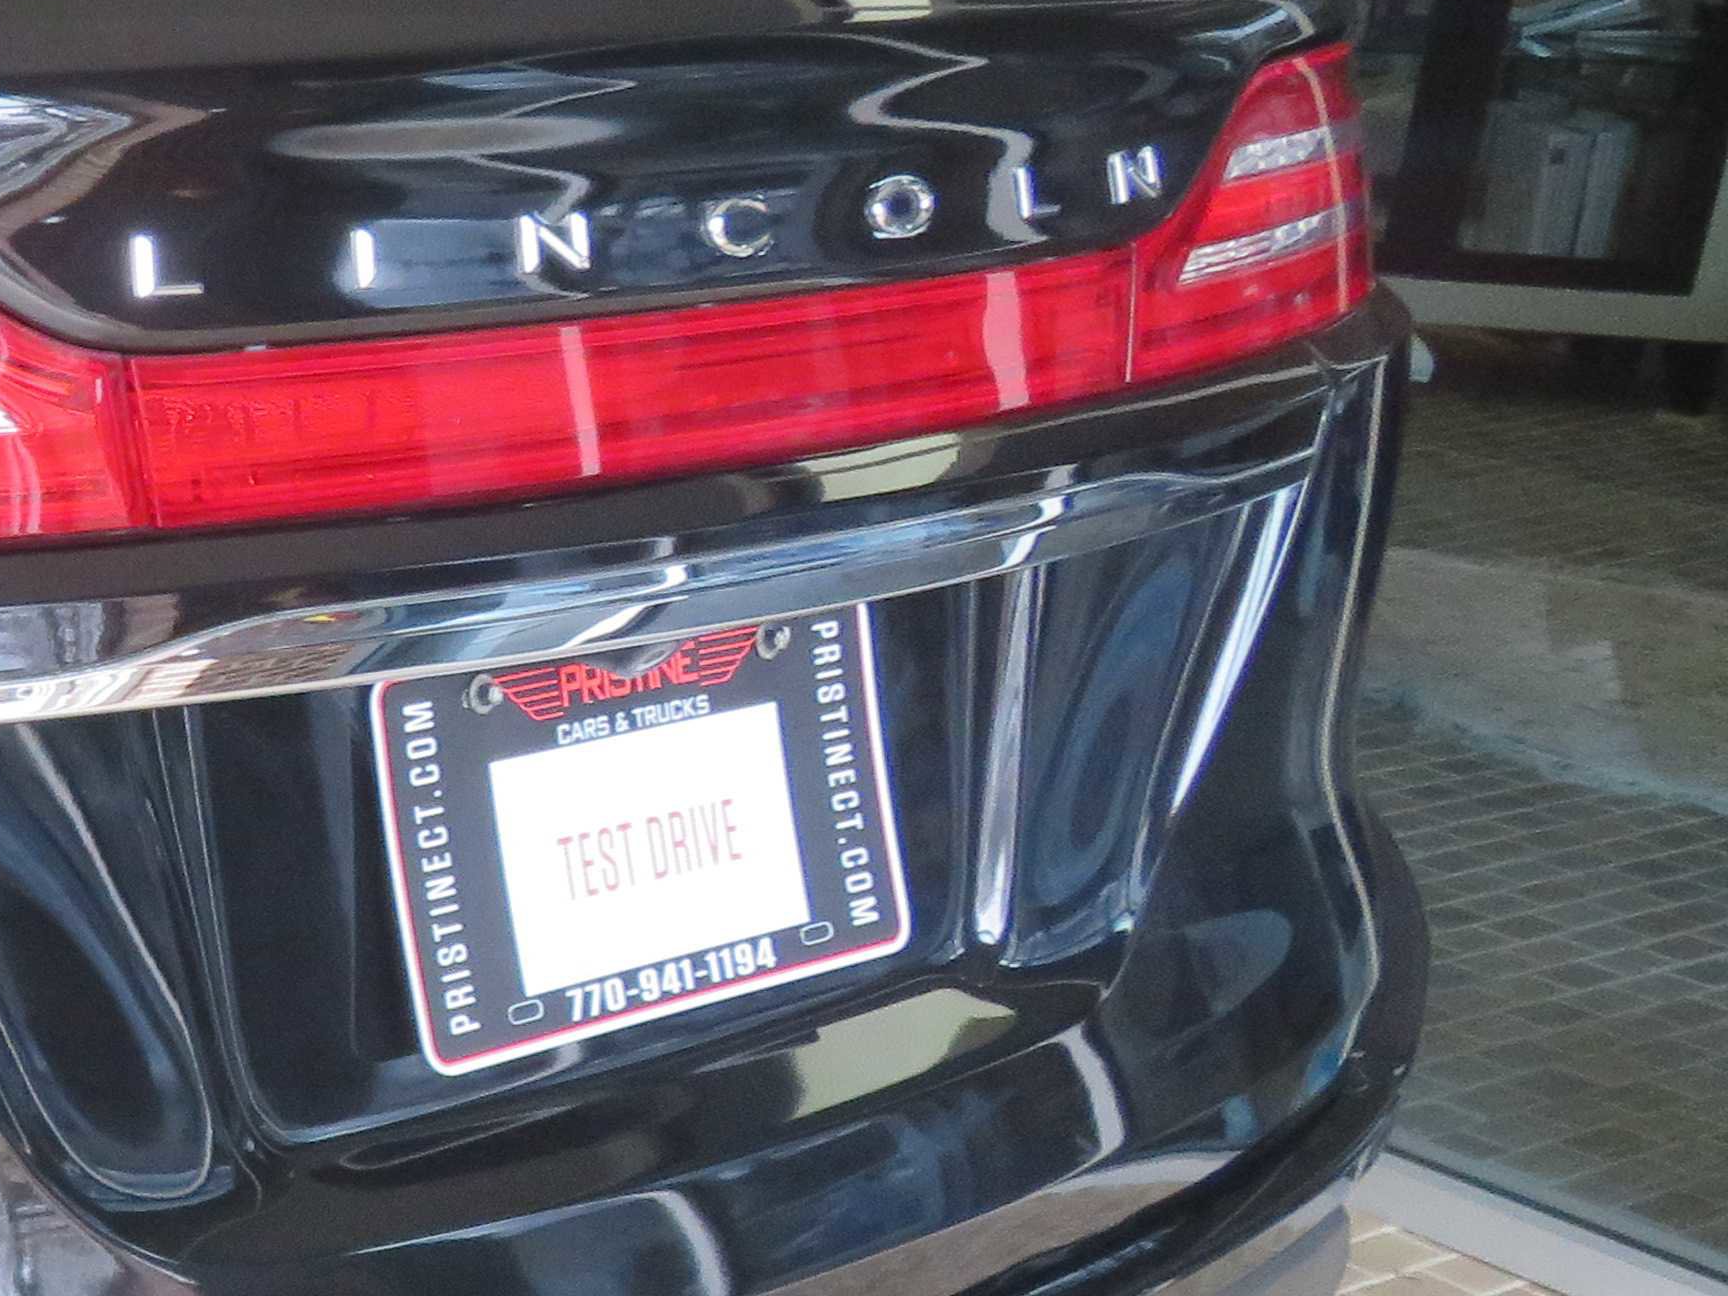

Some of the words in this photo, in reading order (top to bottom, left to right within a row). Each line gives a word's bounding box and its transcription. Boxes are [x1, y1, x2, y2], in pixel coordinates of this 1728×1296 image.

[129, 145, 1163, 299] LINCOLN
[556, 714, 612, 746] CARS
[614, 711, 630, 733] &
[631, 693, 710, 729] TRUCKS
[810, 620, 880, 927] PRISTINECT.COM
[401, 700, 482, 1037] PRISTINECT.COM
[556, 821, 637, 901] TEST
[645, 799, 743, 881] DRIVE
[565, 937, 777, 1023] 770-941-1194
